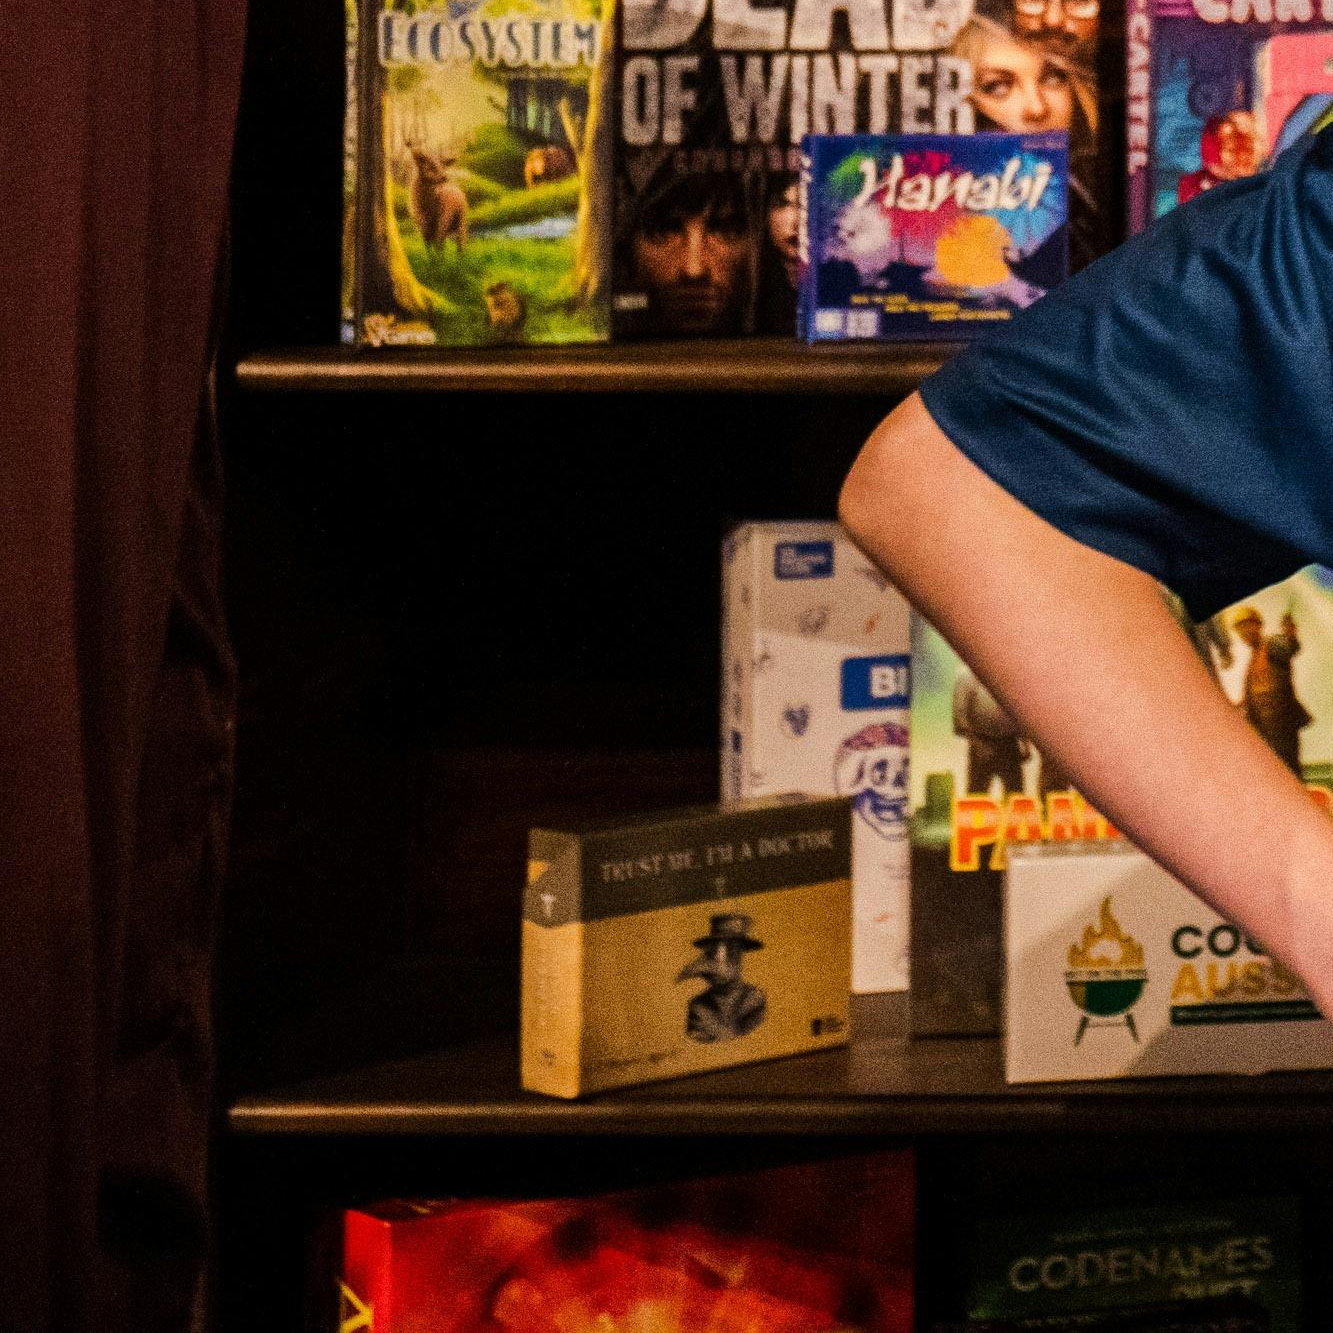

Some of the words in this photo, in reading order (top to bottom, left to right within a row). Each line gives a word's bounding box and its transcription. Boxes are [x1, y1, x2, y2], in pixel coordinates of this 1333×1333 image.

[380, 12, 600, 66] ECOSYSTEM
[623, 56, 696, 147] OF
[716, 52, 977, 145] WINTER
[859, 152, 1053, 212] Hanabi
[1171, 963, 1300, 1000] AUSS
[1009, 1237, 1276, 1294] CODENAMES
